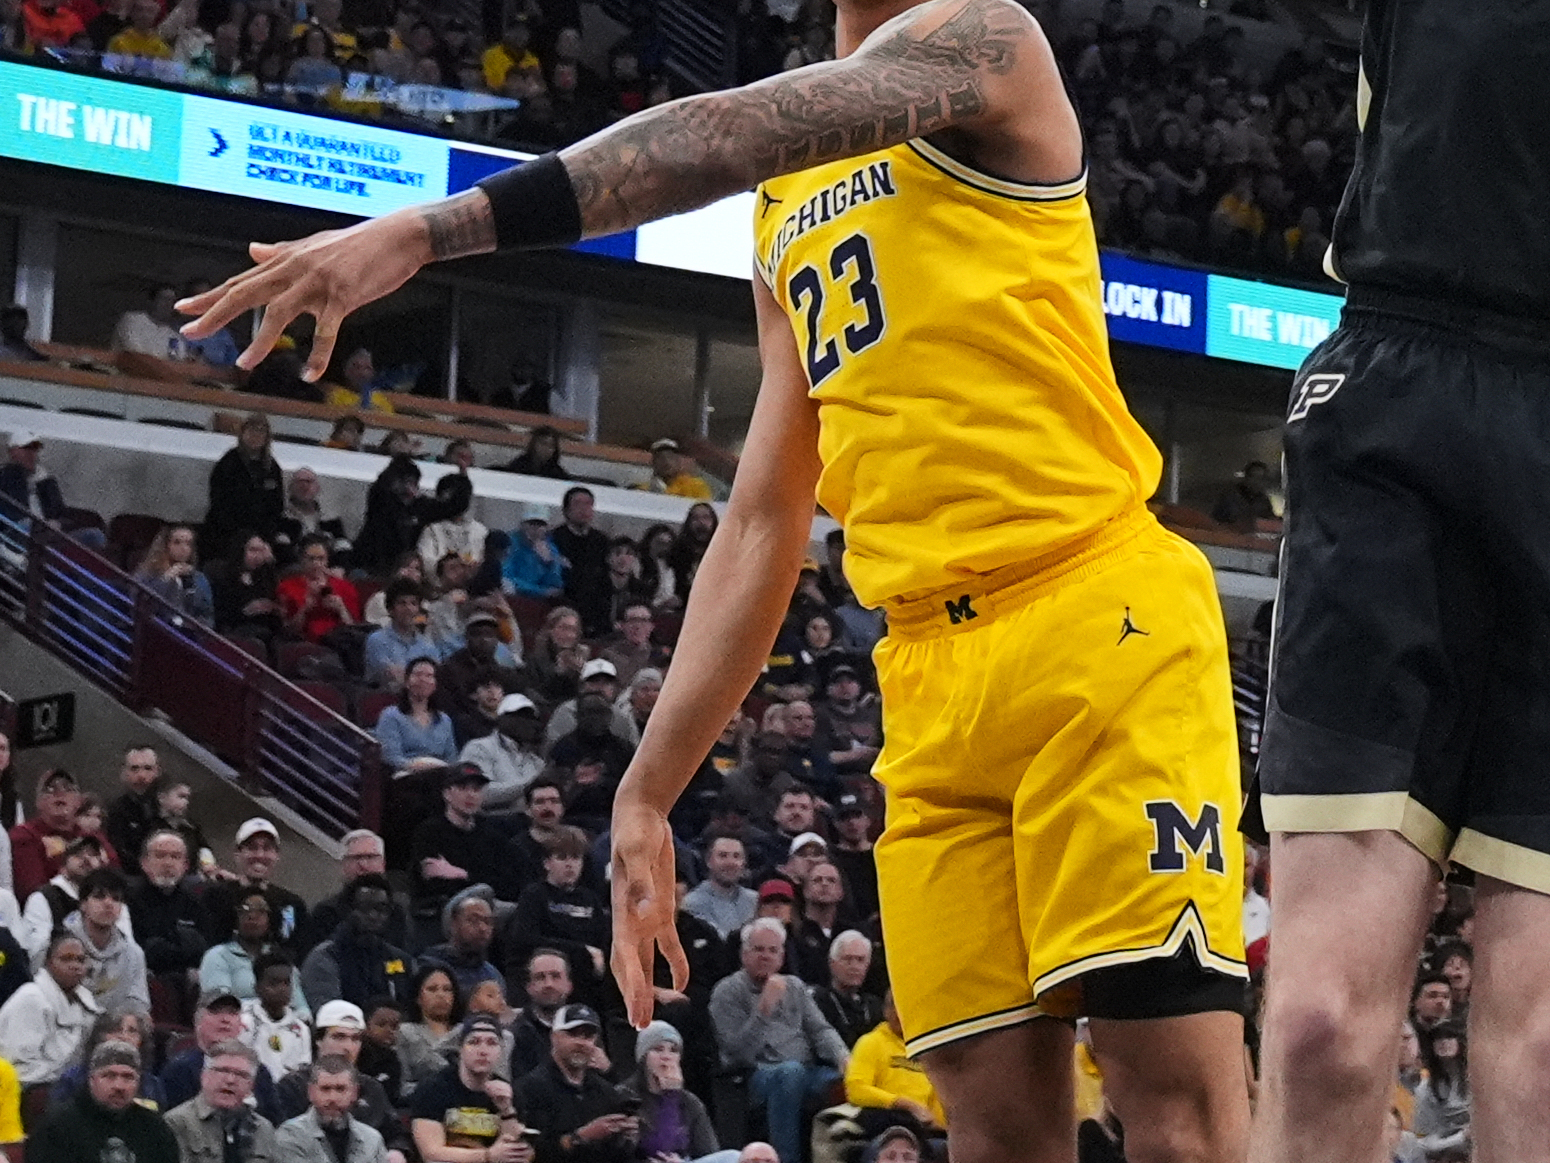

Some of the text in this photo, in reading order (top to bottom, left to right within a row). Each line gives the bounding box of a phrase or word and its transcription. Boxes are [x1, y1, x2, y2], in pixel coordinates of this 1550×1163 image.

[16, 93, 152, 152] THE WIN
[788, 232, 887, 392] 23
[1161, 290, 1191, 328] IN
[1227, 303, 1331, 349] THE WIN
[944, 594, 979, 625] M
[1143, 798, 1225, 878] M
